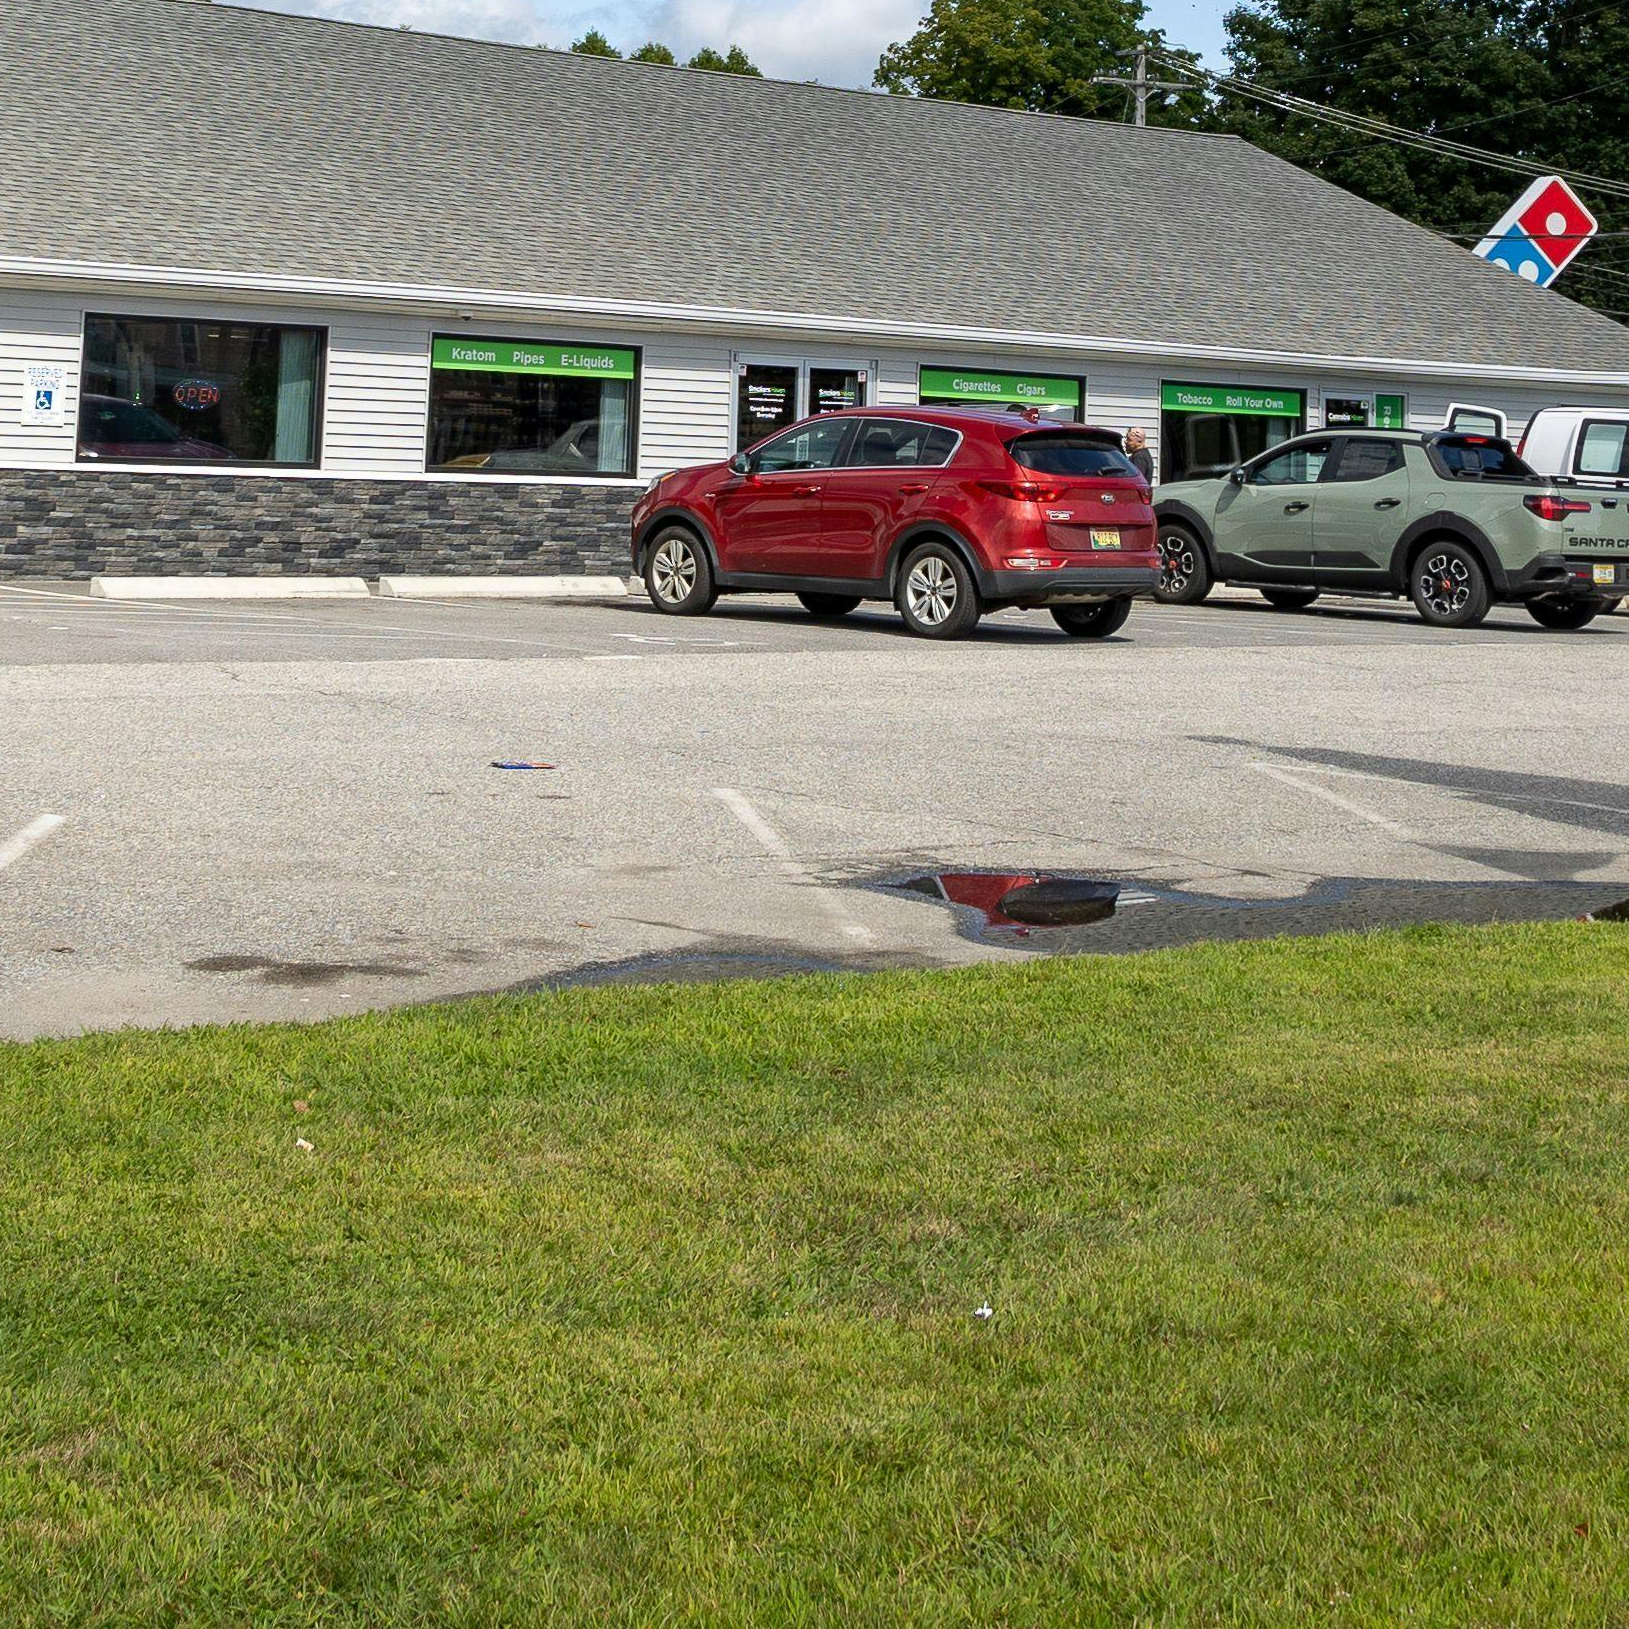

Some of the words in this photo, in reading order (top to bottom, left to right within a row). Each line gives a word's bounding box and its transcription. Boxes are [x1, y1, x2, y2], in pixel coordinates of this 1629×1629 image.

[451, 347, 496, 362] Kratom
[512, 351, 545, 365] Pipes
[560, 354, 614, 369] E-Liquids
[952, 379, 1002, 392] Cigarettes
[1016, 383, 1046, 396] Cigars
[175, 388, 220, 404] OPEN
[1177, 393, 1213, 405] Tobacco
[1226, 396, 1242, 406] Roll
[1244, 397, 1263, 407] Your
[1265, 398, 1283, 408] Own
[1569, 537, 1615, 548] SANTA
